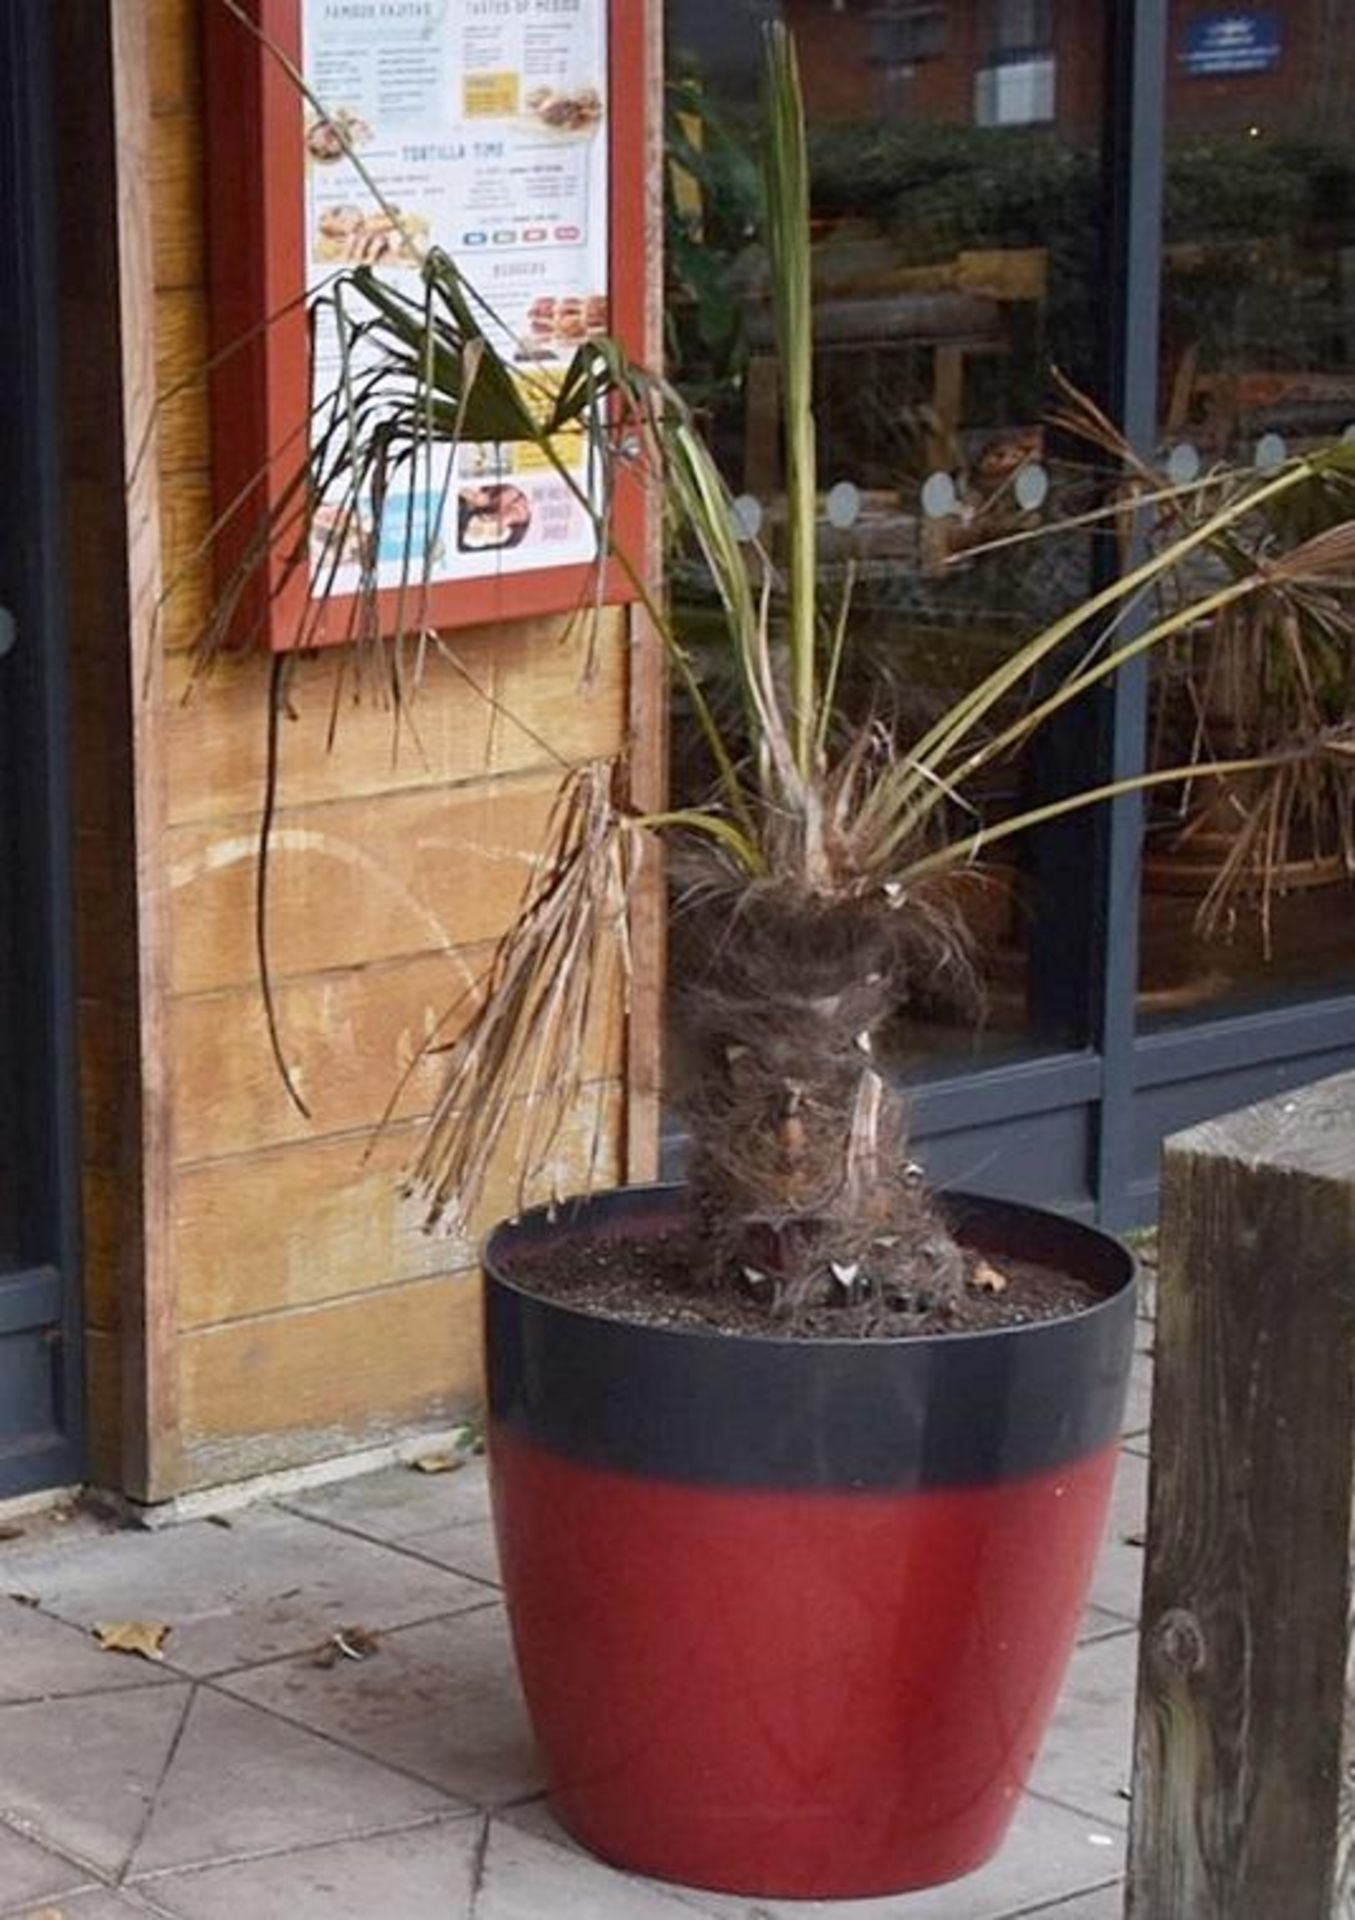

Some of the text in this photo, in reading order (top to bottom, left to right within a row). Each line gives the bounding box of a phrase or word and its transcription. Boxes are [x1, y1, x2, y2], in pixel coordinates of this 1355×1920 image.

[380, 2, 431, 17] FAJITAS
[402, 141, 503, 162] TORTILLA TIME
